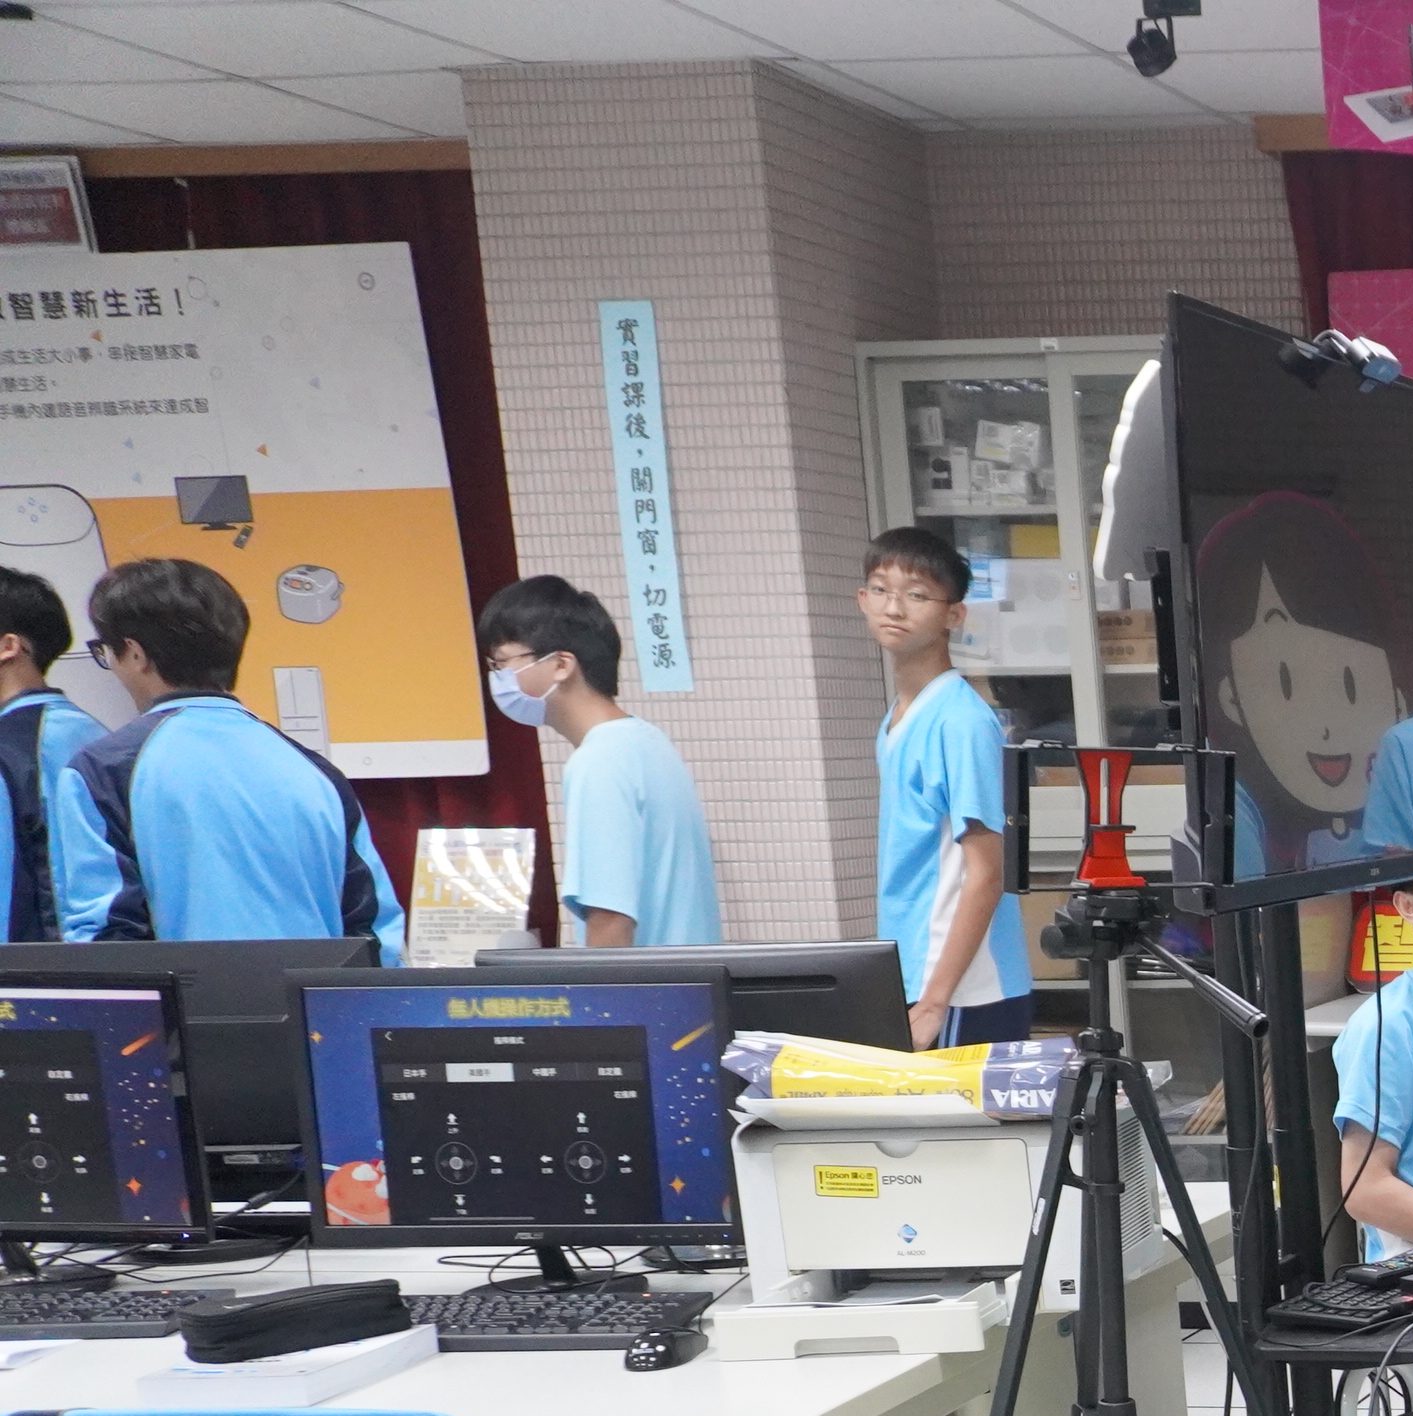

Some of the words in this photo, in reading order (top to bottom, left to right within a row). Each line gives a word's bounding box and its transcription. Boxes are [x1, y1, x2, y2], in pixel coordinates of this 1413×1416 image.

[0, 287, 185, 320] 智慧新生活！
[881, 1175, 922, 1185] EPSON
